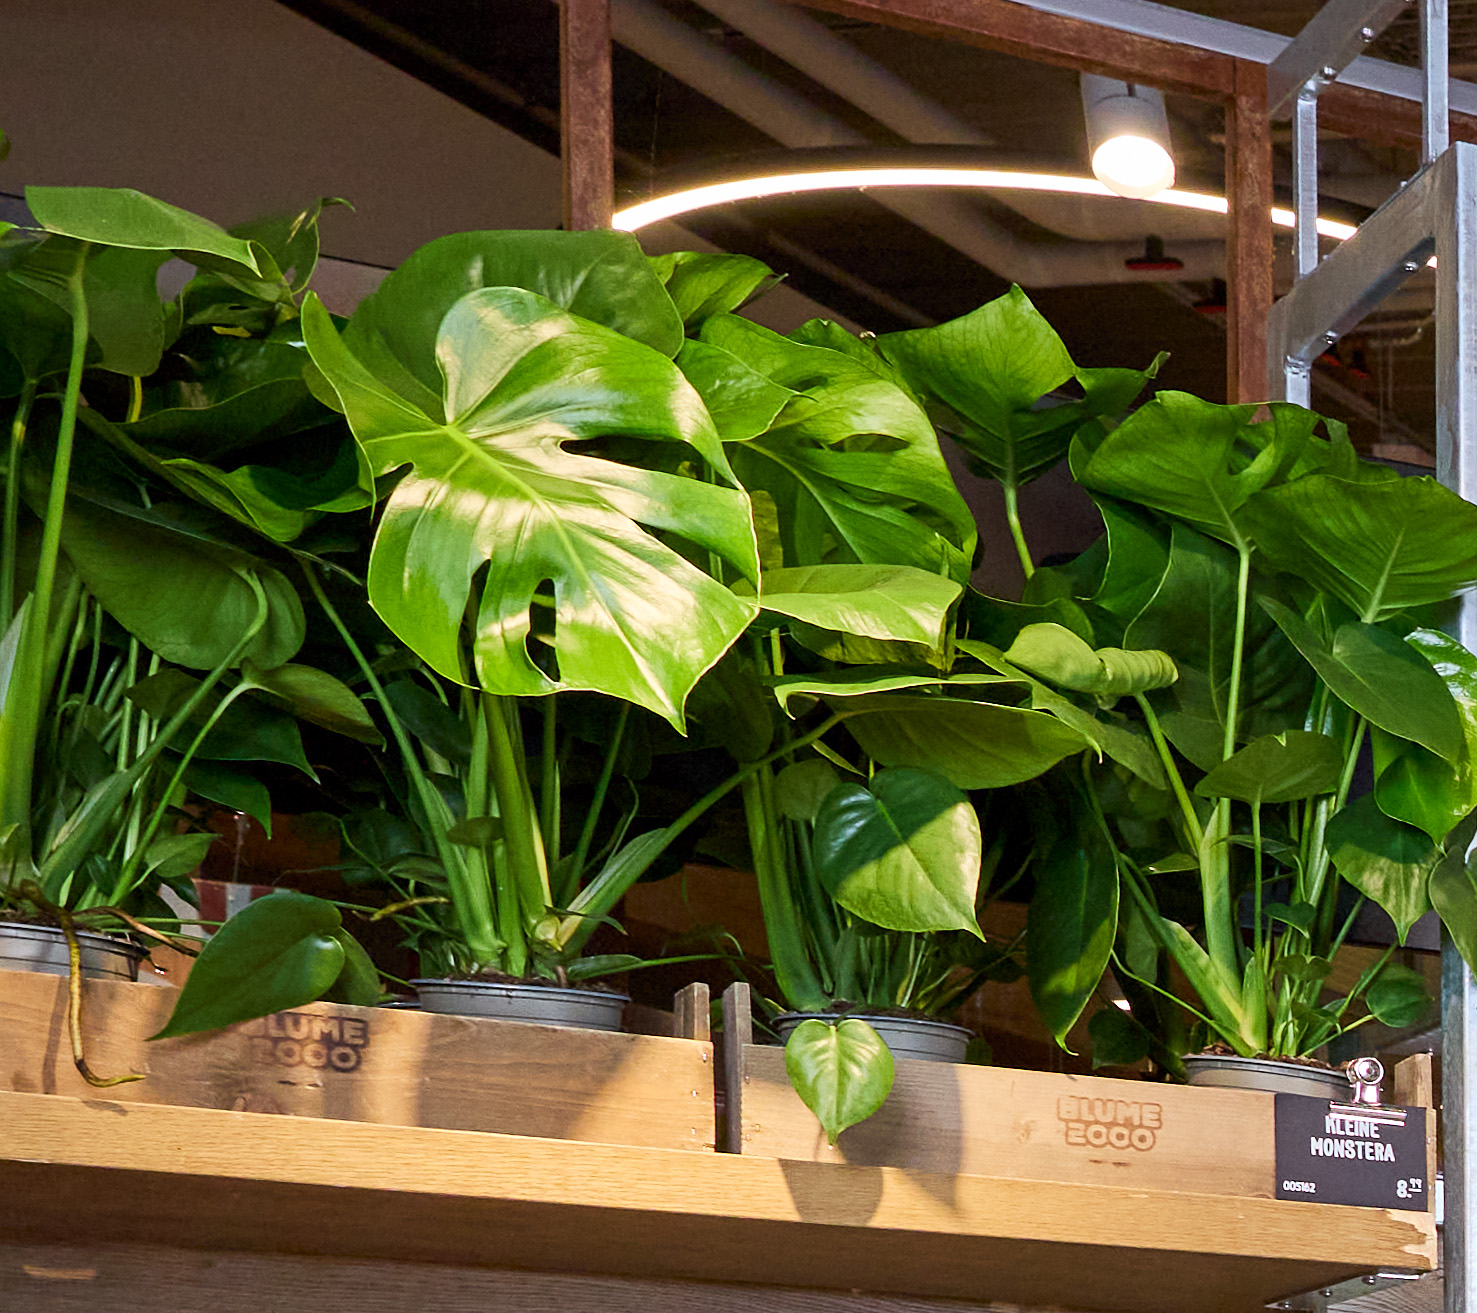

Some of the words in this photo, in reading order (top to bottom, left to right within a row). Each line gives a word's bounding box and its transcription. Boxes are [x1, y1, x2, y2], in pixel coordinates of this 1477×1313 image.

[1057, 1095, 1163, 1129] BLUME
[1065, 1121, 1156, 1151] 2000
[1310, 1137, 1395, 1161] MONSTERA
